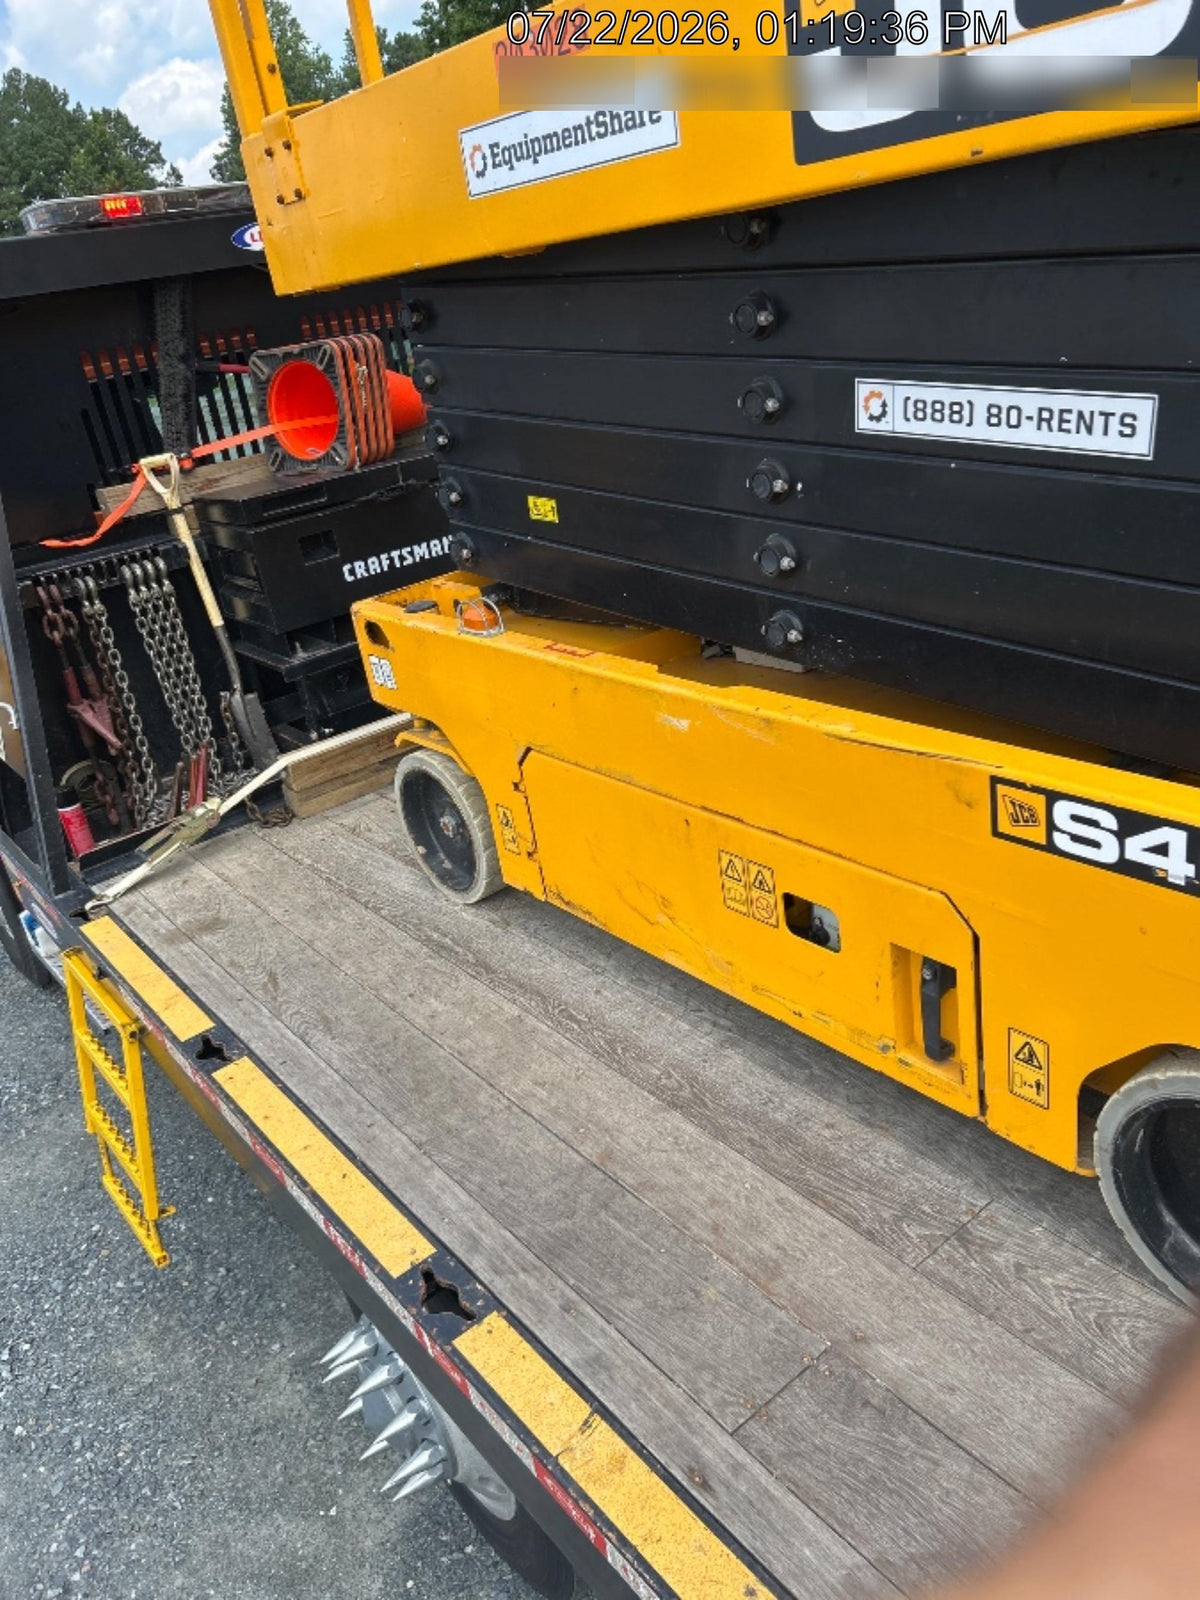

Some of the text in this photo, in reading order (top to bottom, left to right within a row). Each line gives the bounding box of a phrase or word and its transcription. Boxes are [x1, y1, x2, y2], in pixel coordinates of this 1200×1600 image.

[488, 110, 663, 172] EquipmentShare
[902, 396, 1138, 438] (888) 80-RENTS
[1007, 797, 1039, 826] JCB
[1052, 799, 1196, 886] S4
